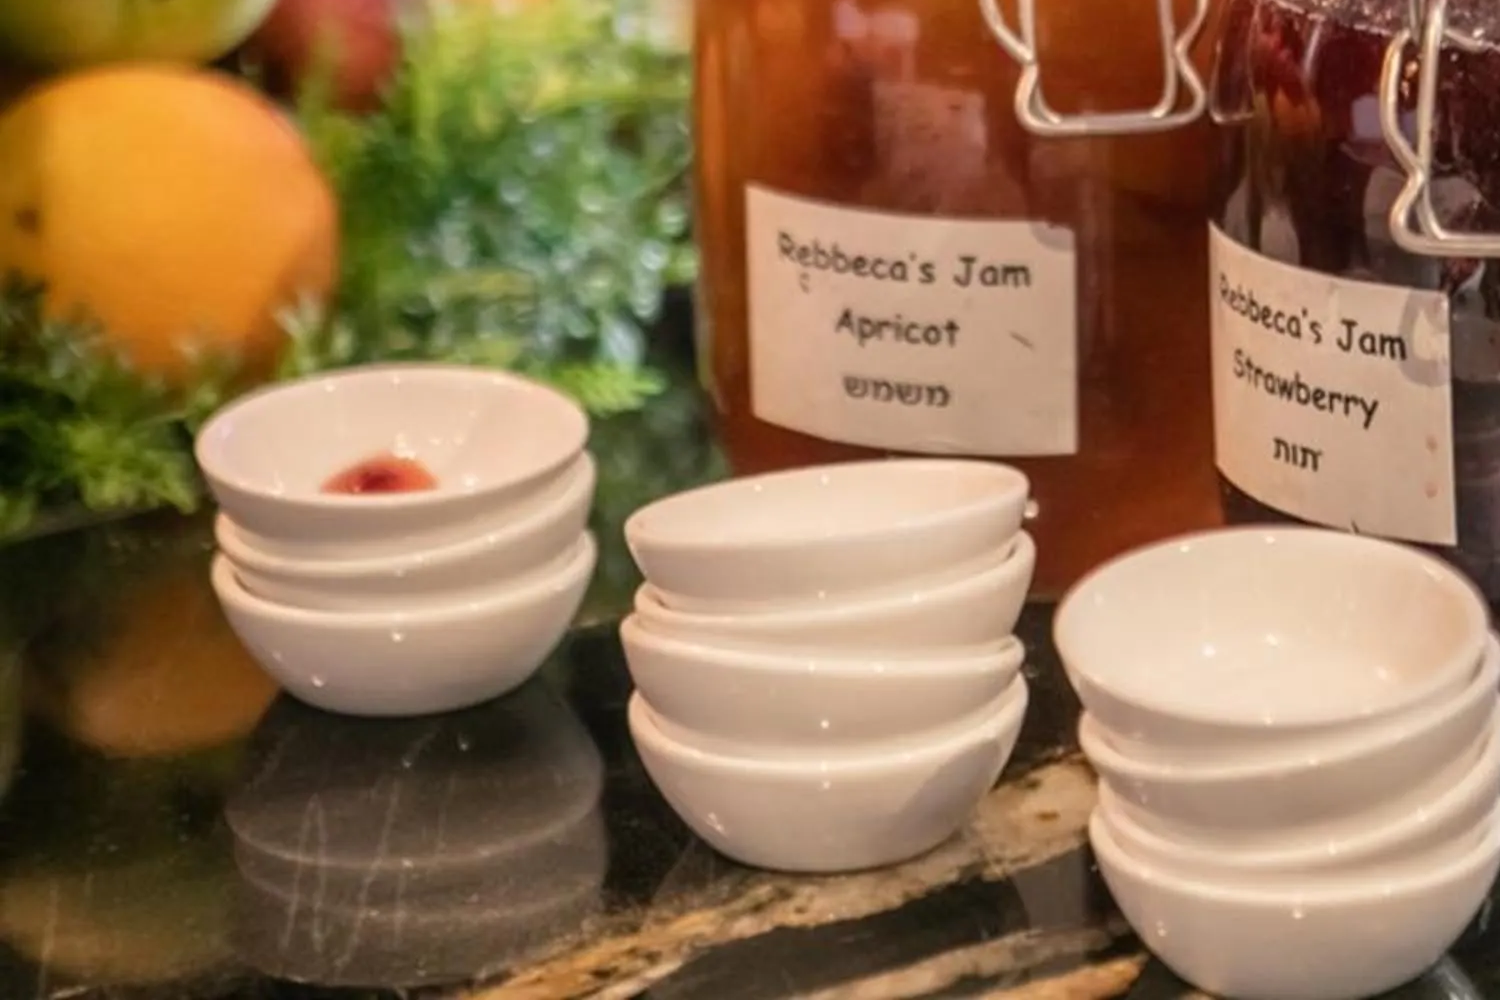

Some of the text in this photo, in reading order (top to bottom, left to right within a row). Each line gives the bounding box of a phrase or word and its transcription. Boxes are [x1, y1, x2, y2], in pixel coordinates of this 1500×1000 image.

[777, 229, 1032, 288] Rebbeca's Jam
[835, 307, 961, 347] Apricot
[1218, 272, 1408, 362] Rebbeca's Jam
[842, 375, 951, 408] משמש
[1232, 348, 1379, 429] Strawberry
[1272, 437, 1323, 473] תות
